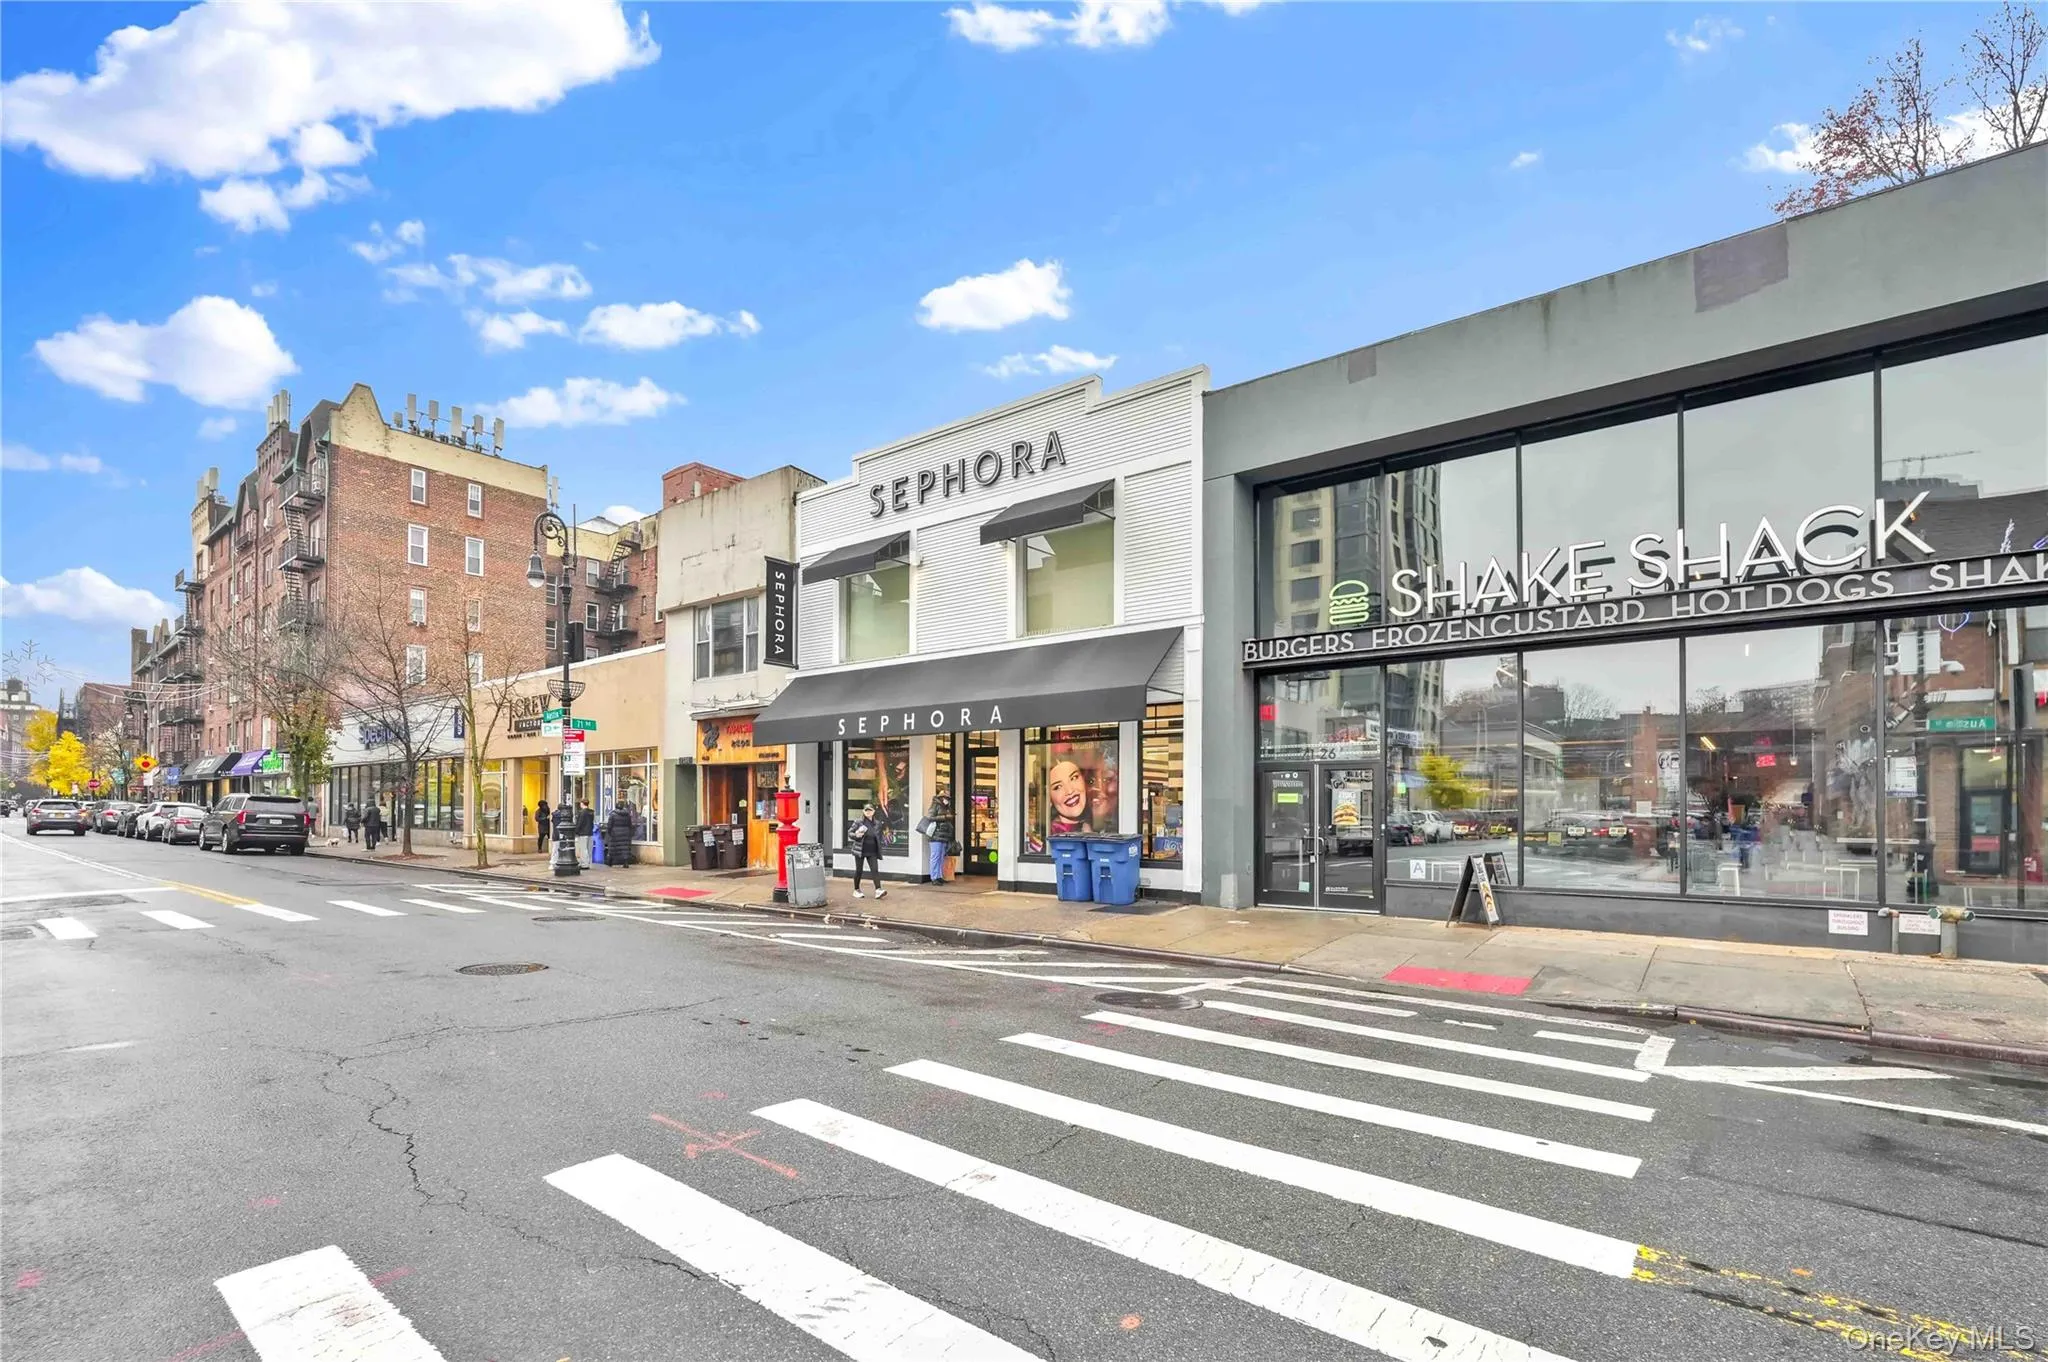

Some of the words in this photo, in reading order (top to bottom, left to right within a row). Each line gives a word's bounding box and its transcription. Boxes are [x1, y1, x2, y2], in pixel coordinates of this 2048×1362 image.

[870, 430, 1066, 518] SEPHORA
[1389, 539, 1606, 618] SHAKE
[1626, 490, 1936, 590] SHACK
[774, 571, 786, 654] SEPHORA
[1244, 632, 1354, 661] BURGERS
[1372, 616, 1485, 648] FROZEN
[1490, 600, 1646, 636] CUSTARD
[1671, 586, 1755, 618] HOT
[1766, 571, 1894, 609] DOGS
[519, 719, 541, 728] FACTOR
[838, 705, 1003, 735] SEPHORA
